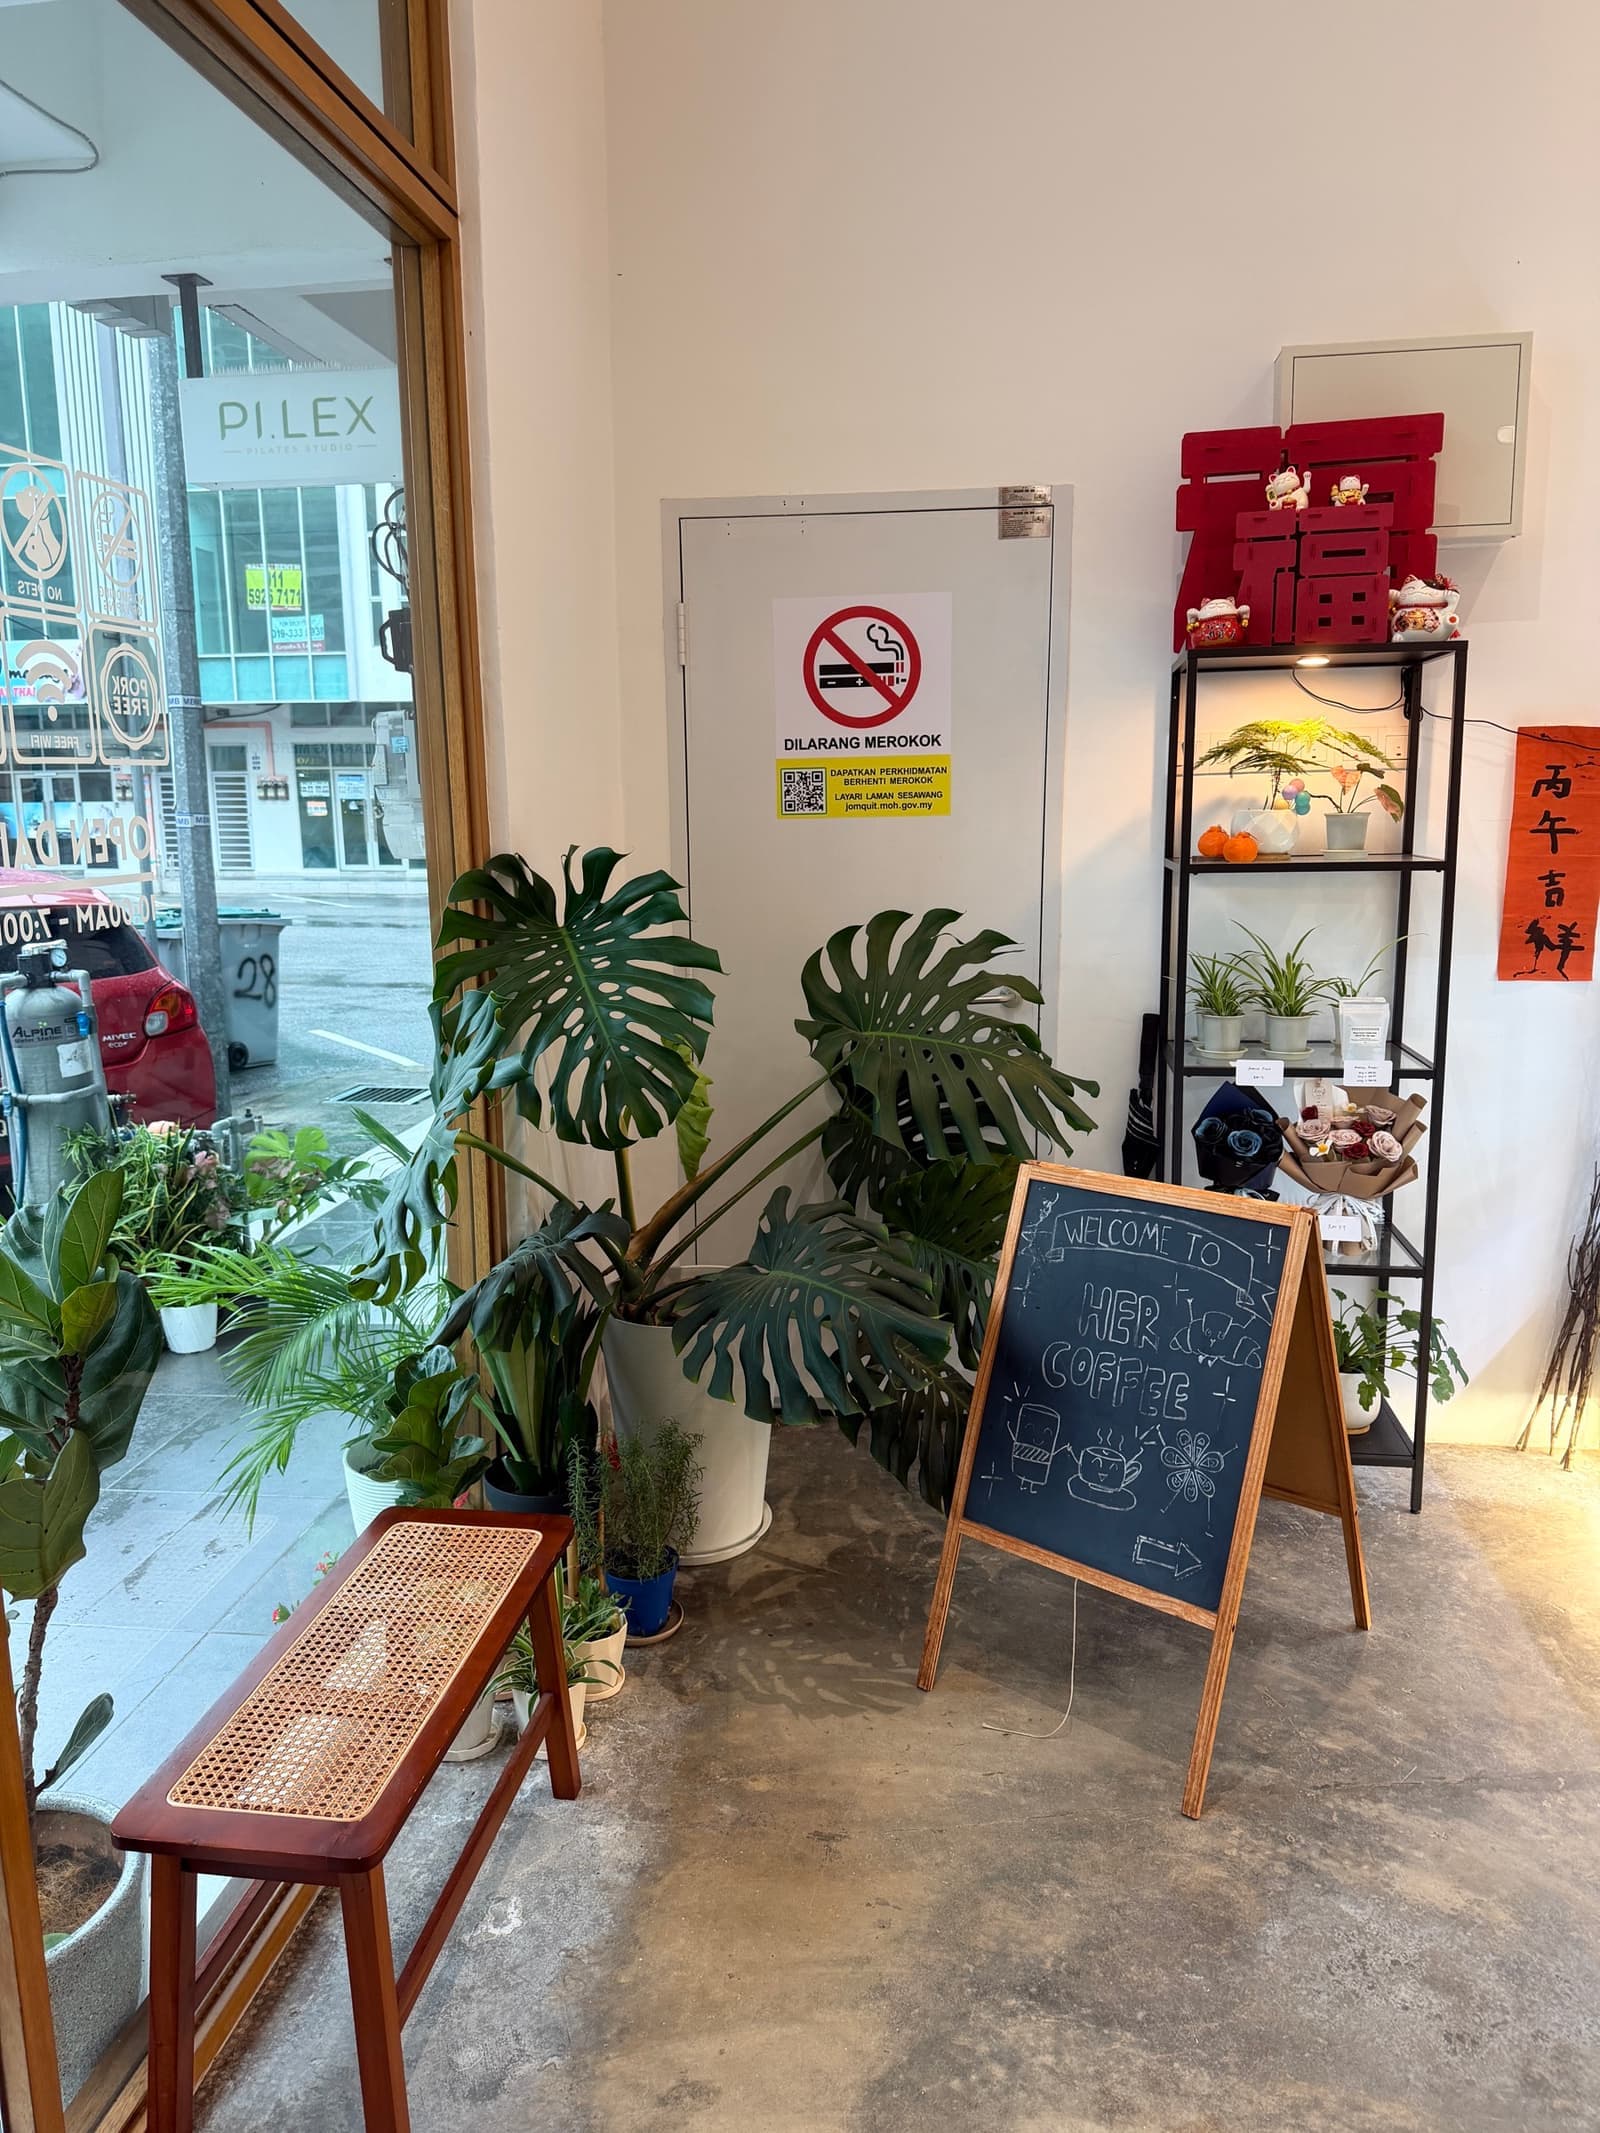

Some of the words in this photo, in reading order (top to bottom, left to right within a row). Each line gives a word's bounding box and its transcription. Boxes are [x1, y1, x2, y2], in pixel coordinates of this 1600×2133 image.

[219, 396, 377, 440] PI.LEX
[306, 442, 353, 453] STUDIO
[784, 737, 861, 751] DILARANG
[864, 734, 942, 749] MEROKOK
[830, 768, 876, 777] DAPATKAN
[879, 766, 948, 776] PERKHIDMATAN
[843, 777, 886, 786] BERHENTI
[889, 776, 934, 785] MEROKOK
[834, 792, 863, 801] LAYARI
[866, 792, 894, 800] LAMAN
[897, 790, 943, 799] SESAWANG
[845, 801, 933, 812] jomquit.moh.gov.my
[233, 953, 277, 1009] 28
[12, 1026, 62, 1038] ALPINE
[102, 1031, 137, 1042] MIVEC
[1063, 1215, 1173, 1257] WELCOME
[1186, 1232, 1221, 1267] TO
[1078, 1281, 1161, 1351] HER
[1041, 1341, 1191, 1421] COFFEE
